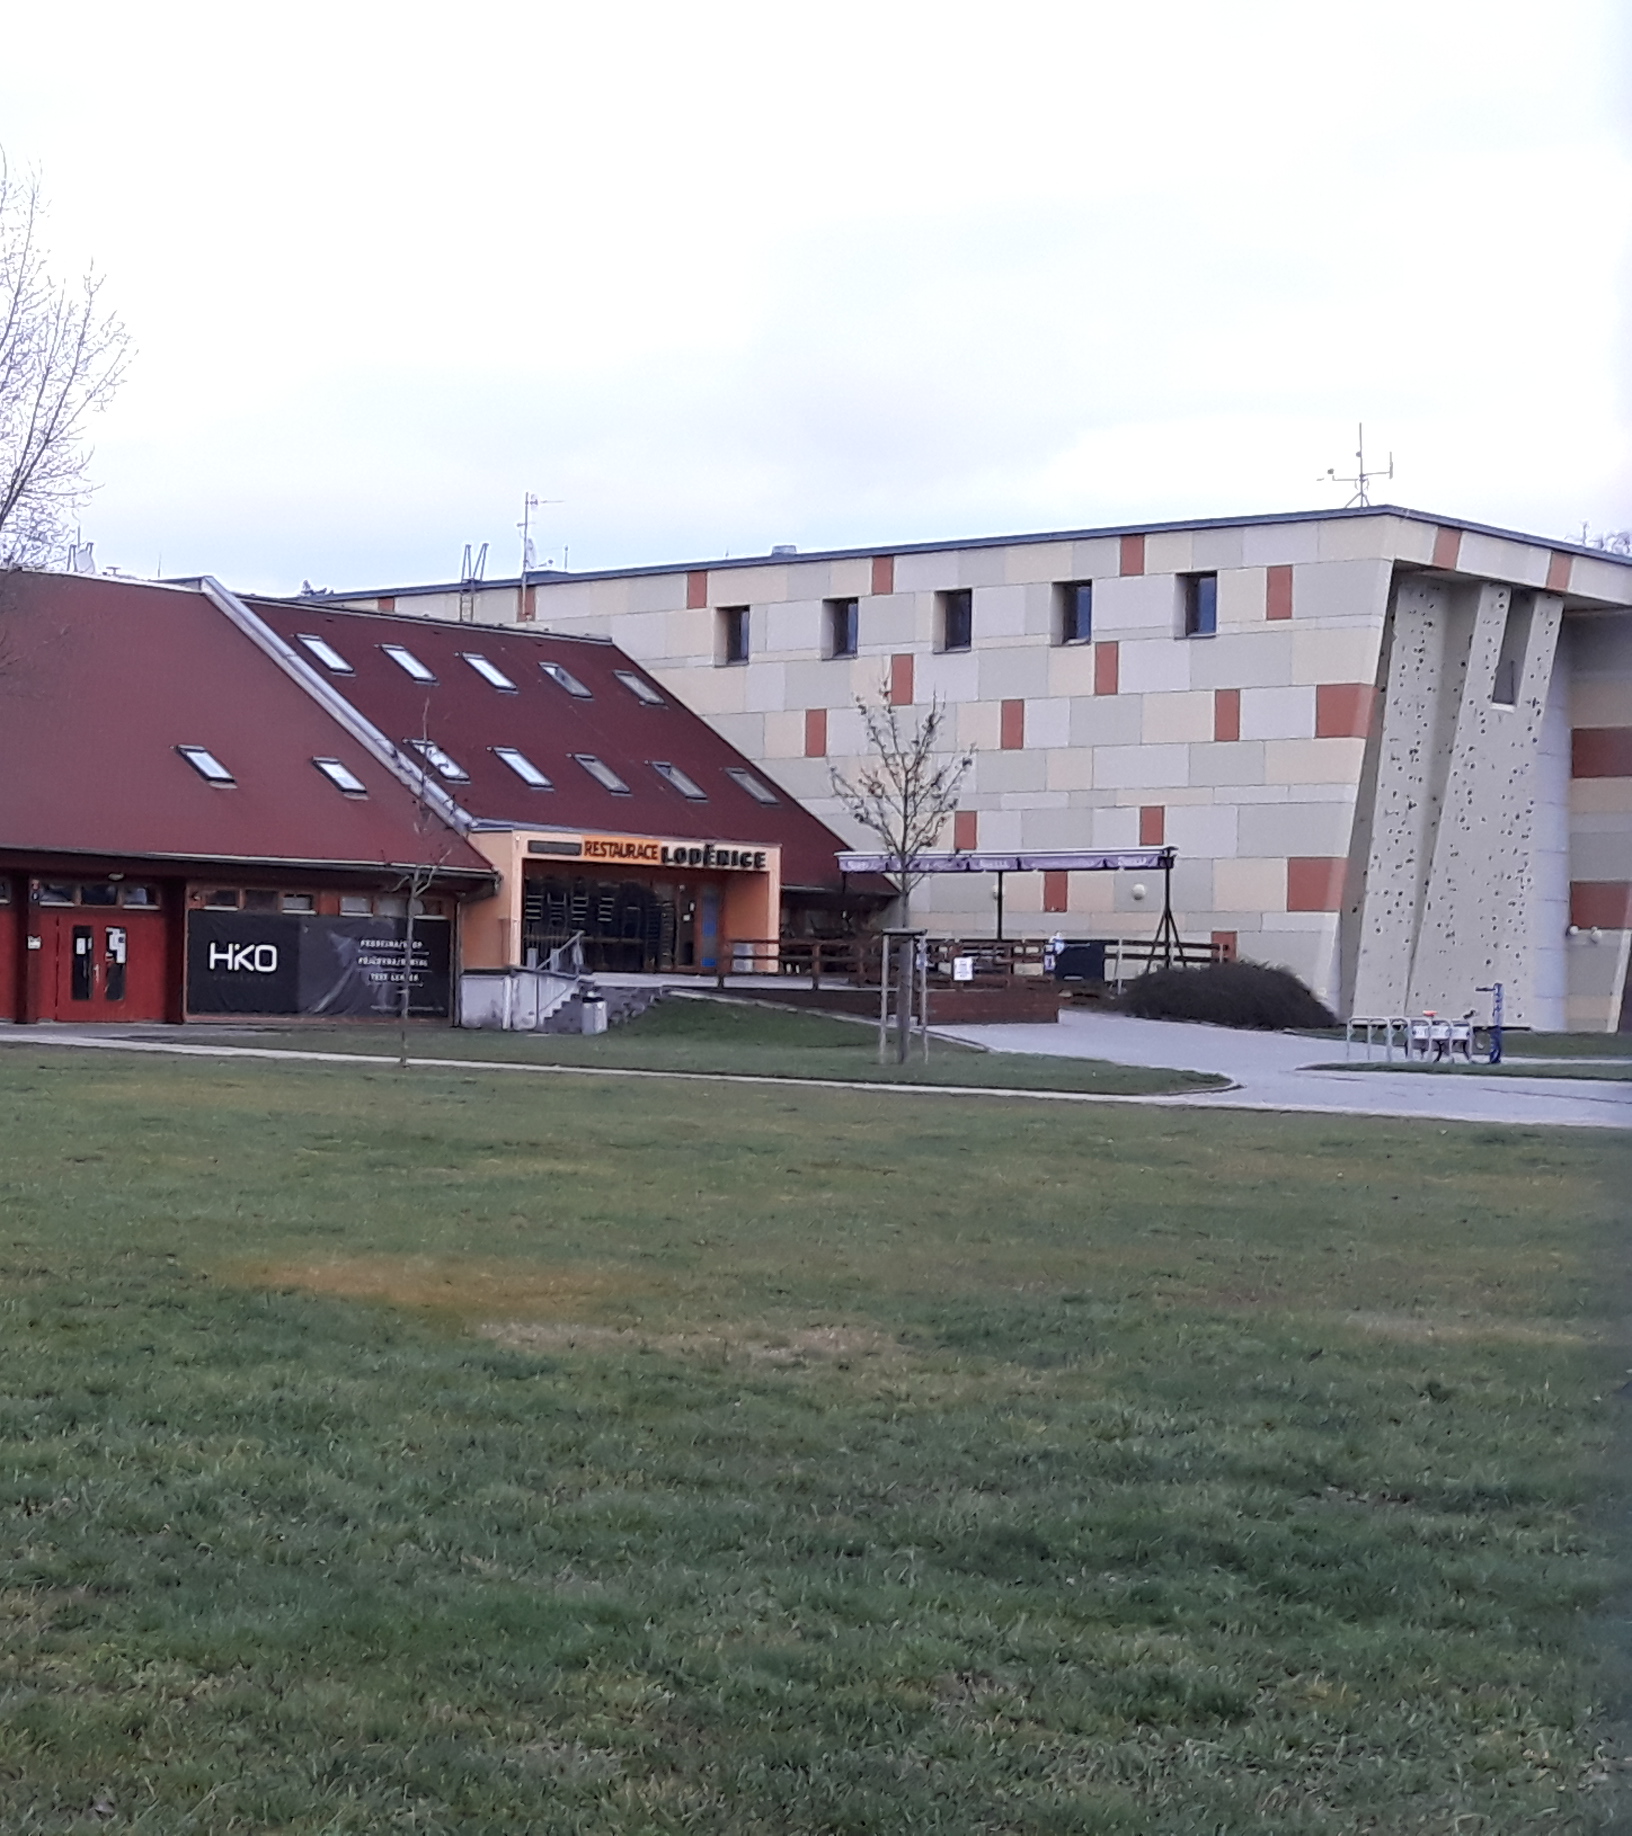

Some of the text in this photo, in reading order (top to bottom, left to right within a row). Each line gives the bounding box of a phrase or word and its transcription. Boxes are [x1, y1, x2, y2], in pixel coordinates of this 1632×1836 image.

[584, 841, 766, 869] RESTAURACE LODĚNICE
[209, 942, 278, 973] HKO
